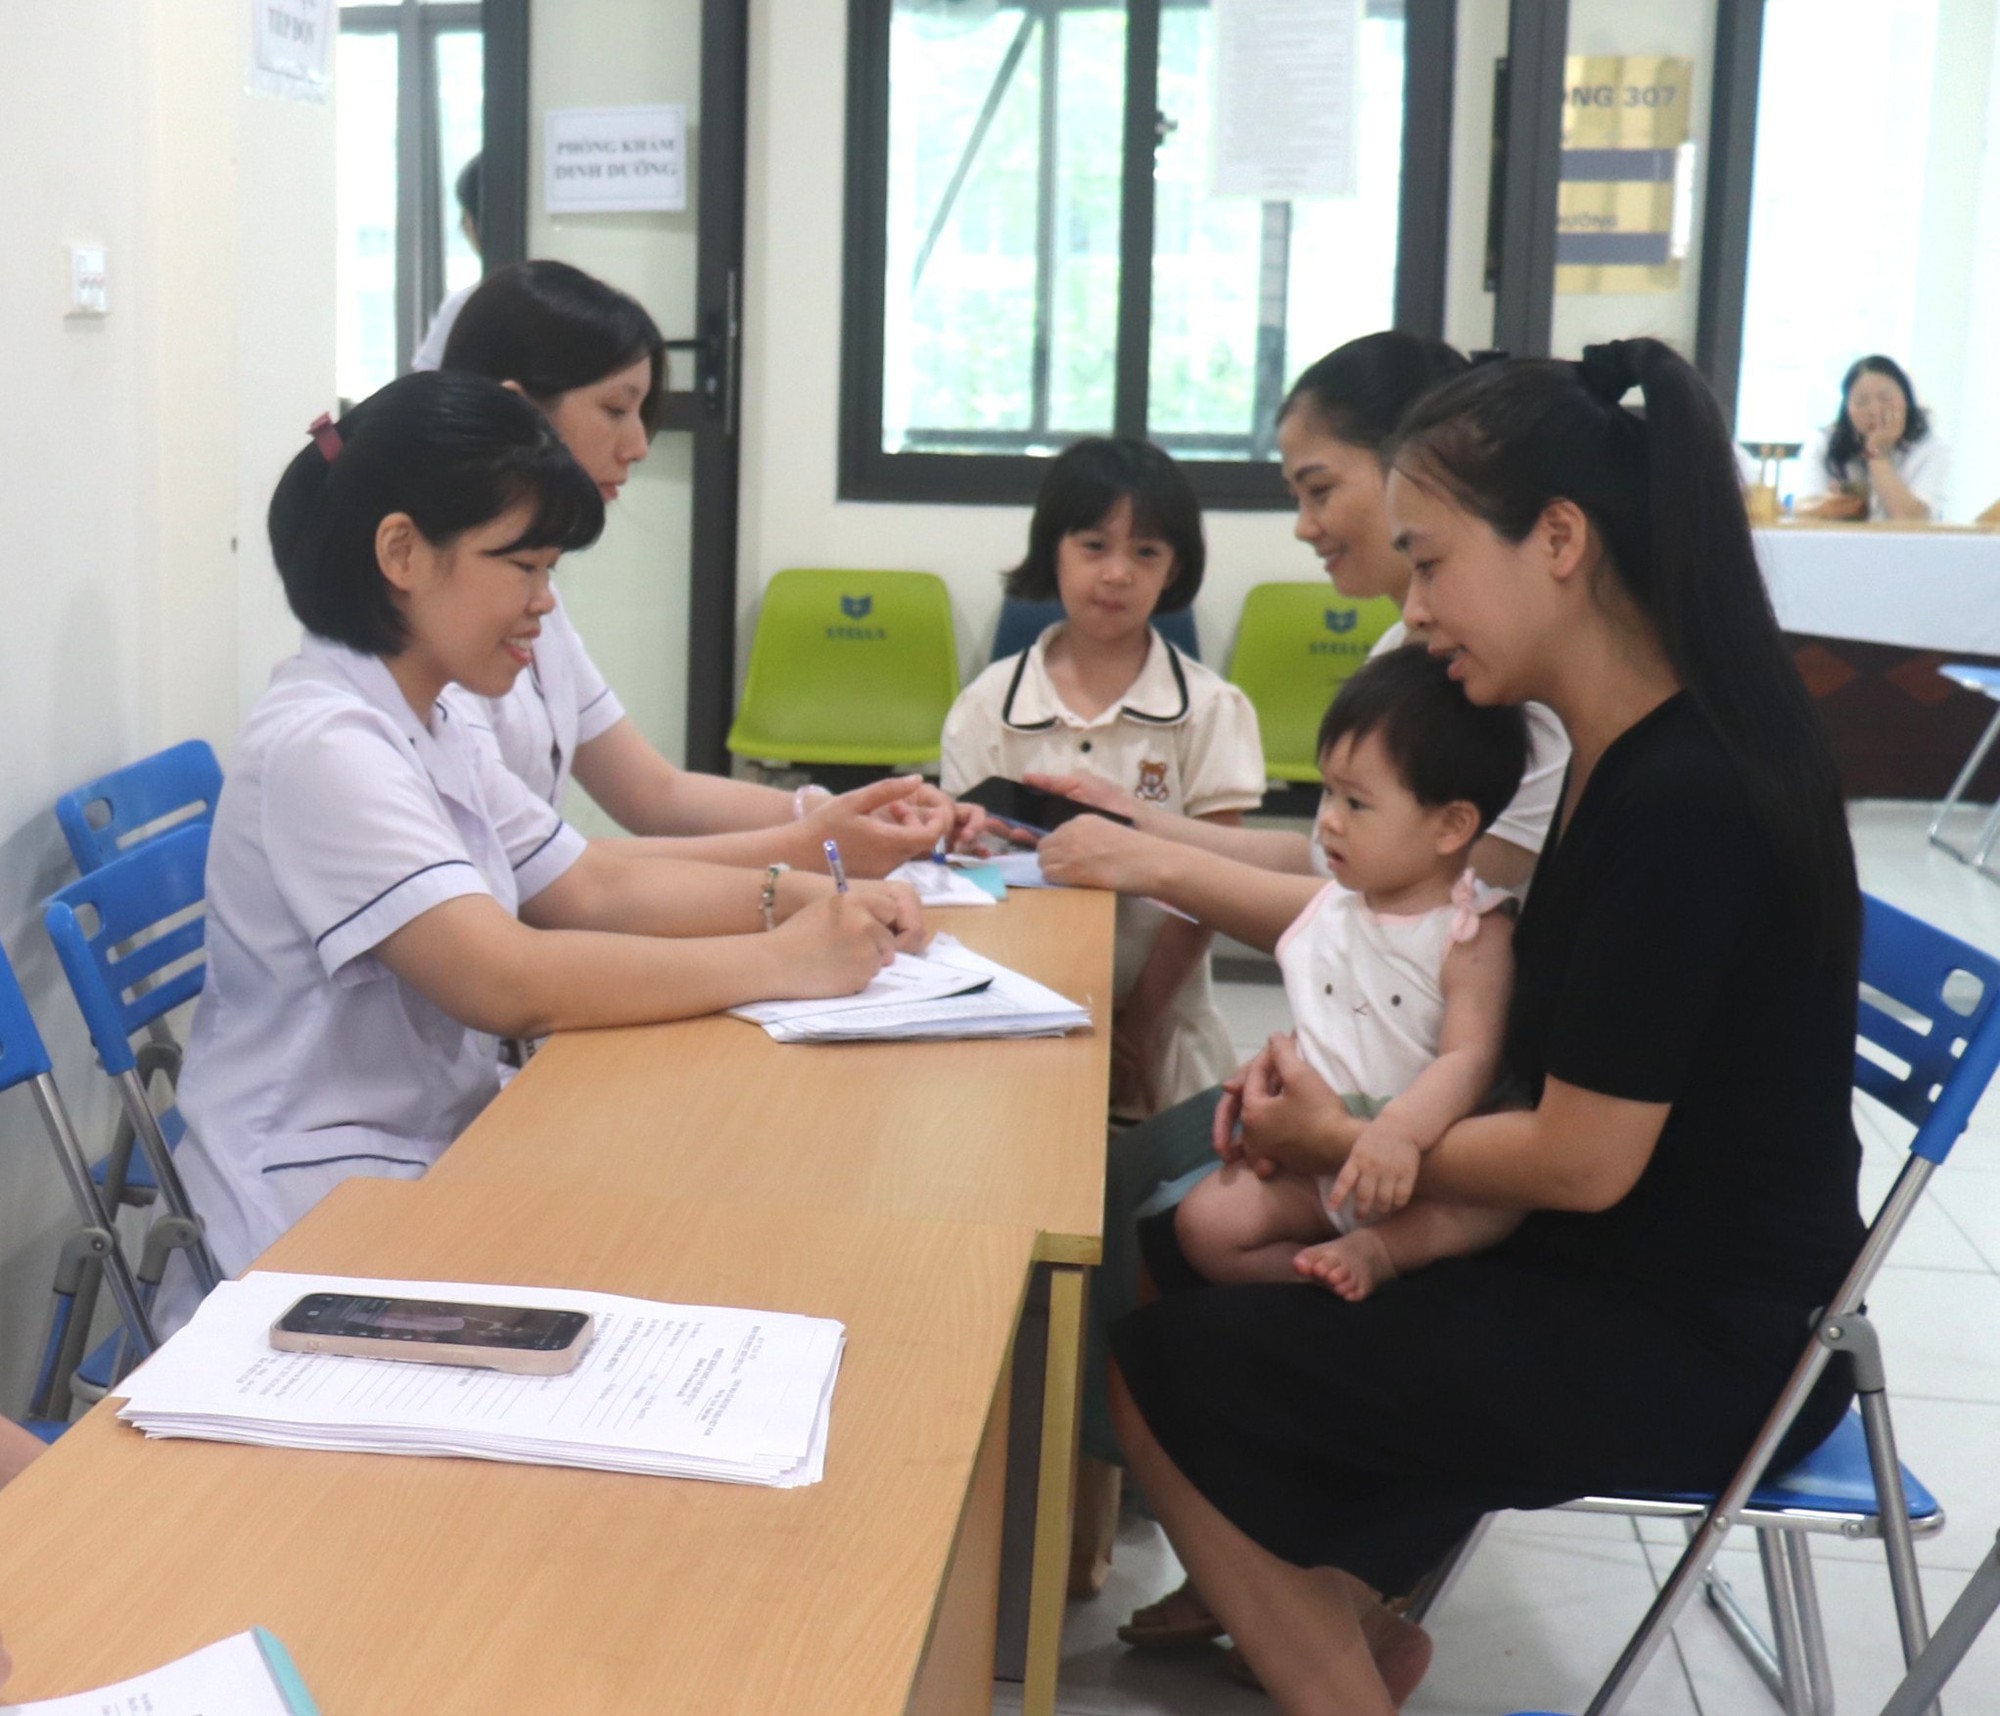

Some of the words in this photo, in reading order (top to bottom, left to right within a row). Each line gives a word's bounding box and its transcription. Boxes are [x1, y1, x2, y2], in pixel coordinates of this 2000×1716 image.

[1624, 85, 1676, 107] 307
[554, 164, 602, 180] DINH
[825, 626, 888, 641] STELLA
